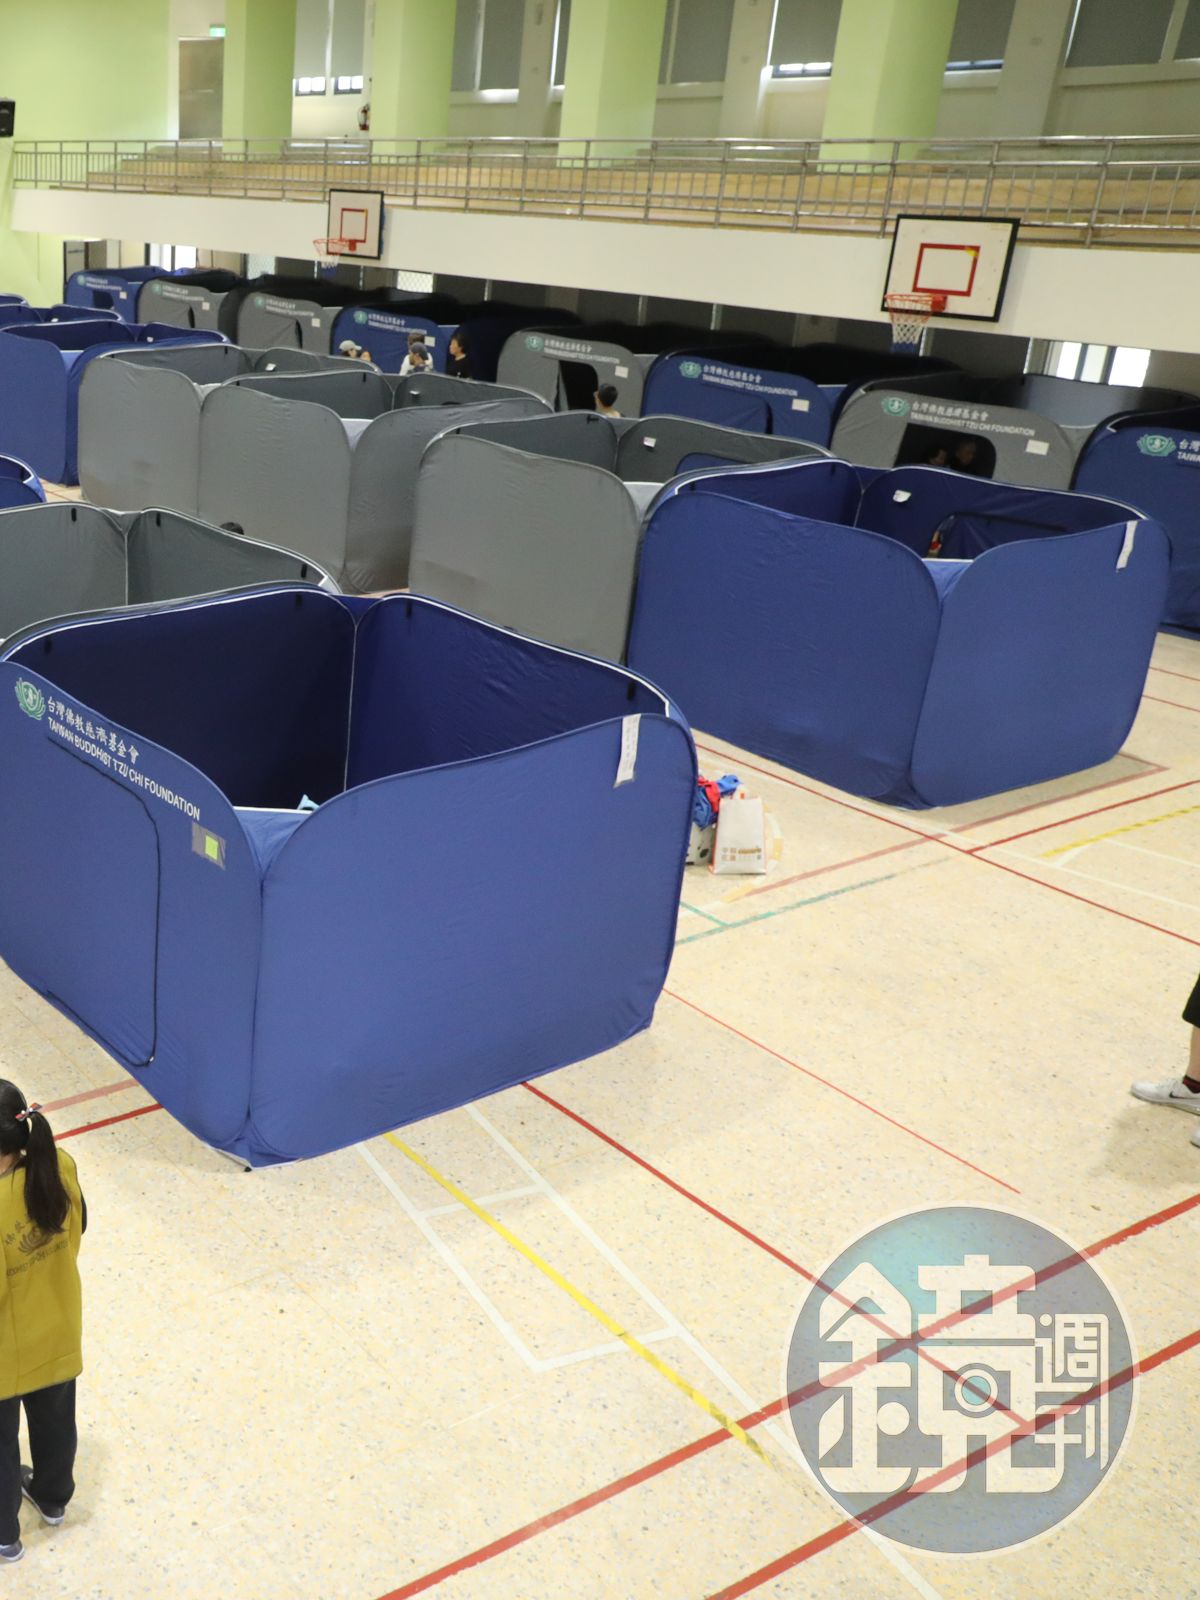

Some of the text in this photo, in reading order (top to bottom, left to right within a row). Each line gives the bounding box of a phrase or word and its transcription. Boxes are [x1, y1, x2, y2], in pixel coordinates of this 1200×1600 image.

[47, 696, 139, 764] 台灣佛教慈濟基金會
[48, 716, 200, 821] TAIWAN BUDDHIST TZU CHI FOUNDATION
